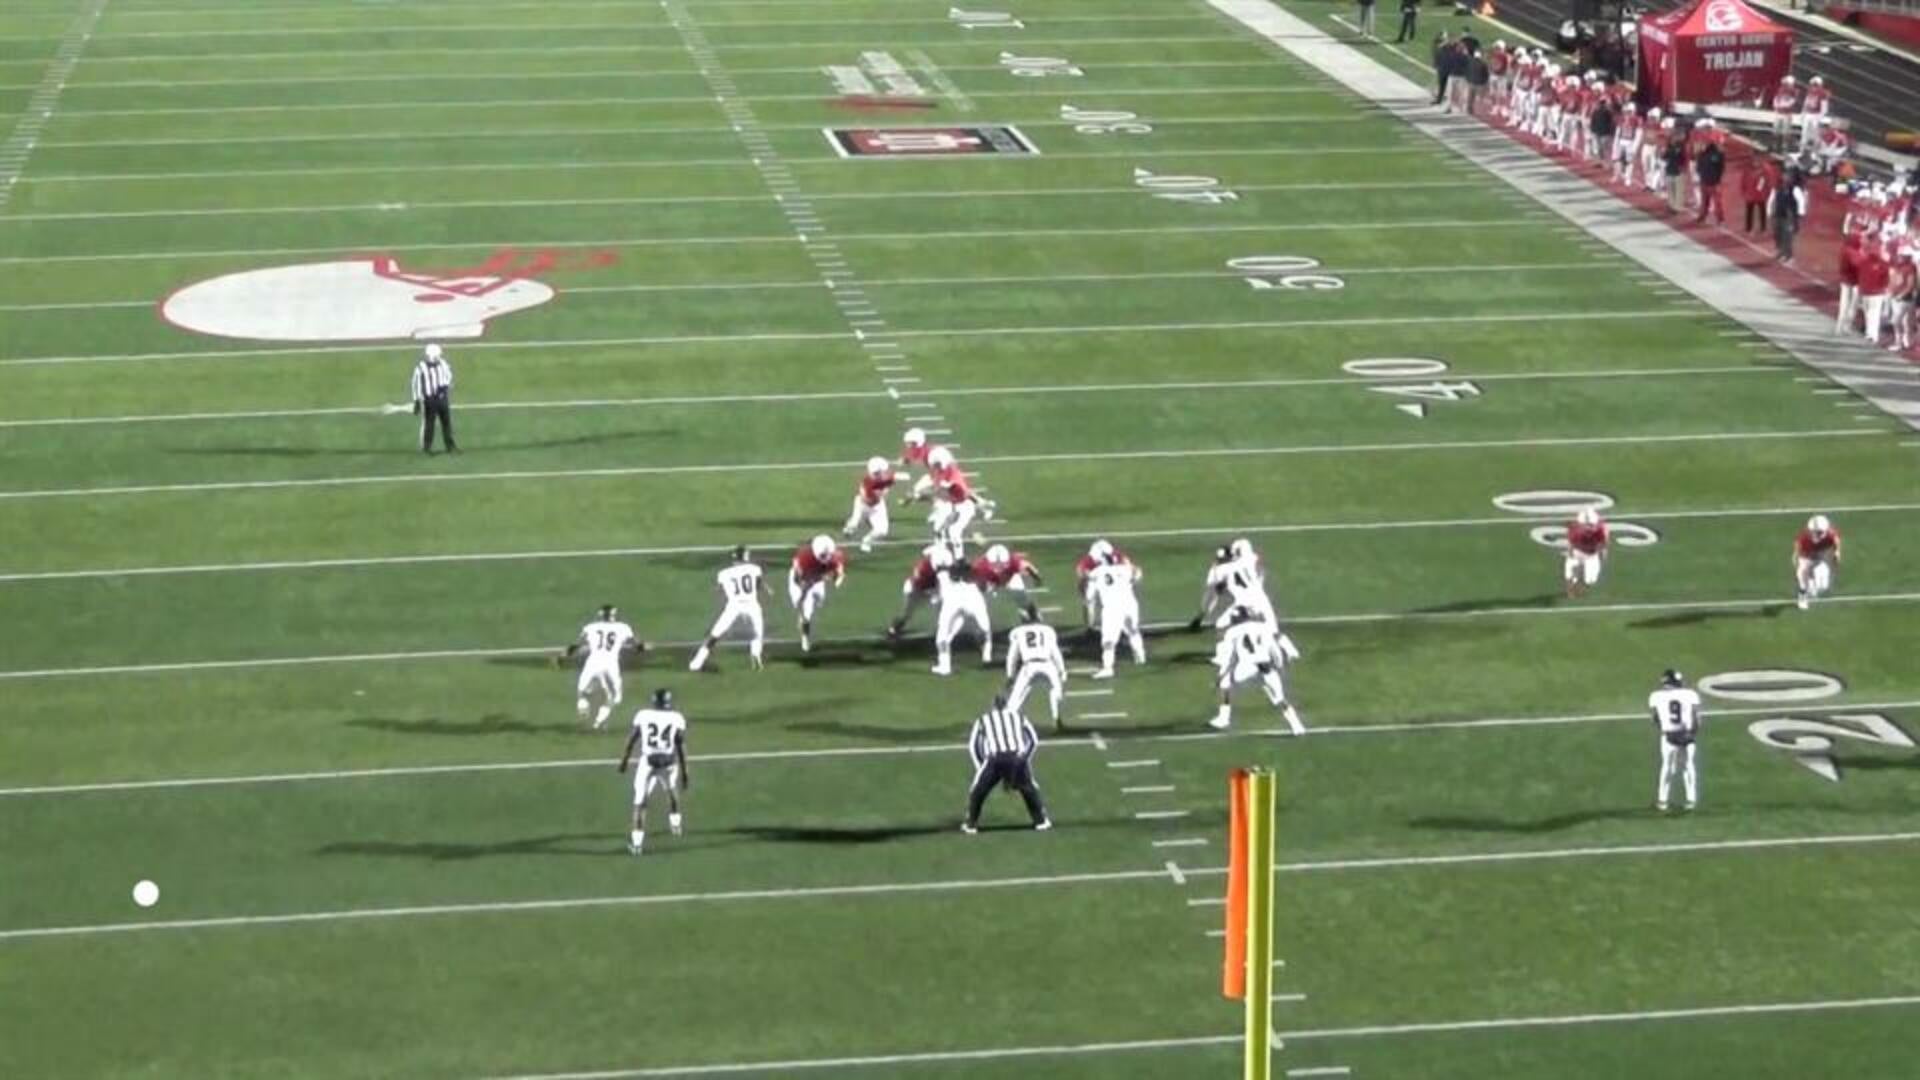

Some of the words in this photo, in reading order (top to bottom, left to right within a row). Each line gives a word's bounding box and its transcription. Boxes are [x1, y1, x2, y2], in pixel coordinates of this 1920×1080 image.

[1703, 51, 1764, 70] TROJAN
[1060, 111, 1153, 134] 30
[1134, 175, 1240, 203] 40
[1225, 255, 1345, 289] 50
[1341, 357, 1481, 401] 40
[731, 574, 753, 596] 10
[1025, 630, 1046, 648] 21
[1666, 699, 1682, 725] 9
[1698, 670, 1917, 752] 20
[647, 722, 673, 749] 24
